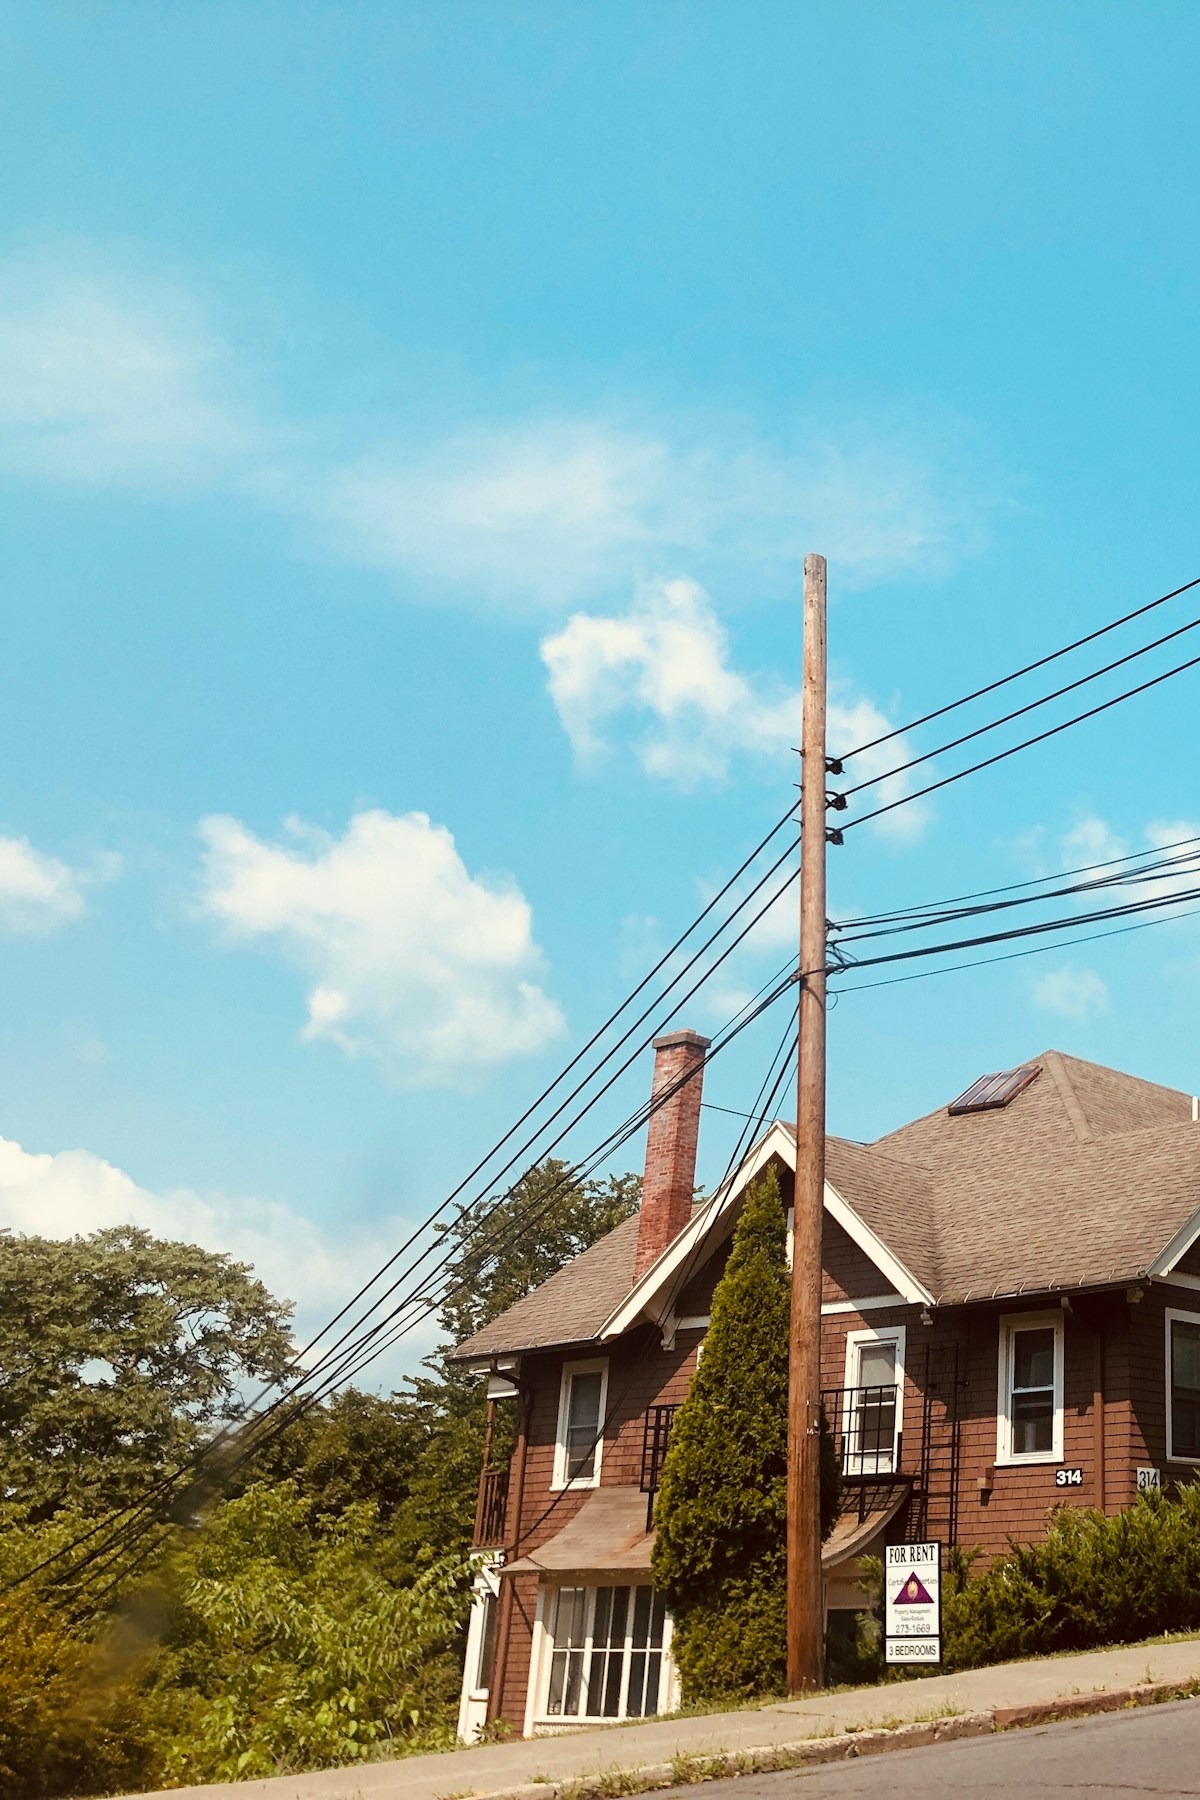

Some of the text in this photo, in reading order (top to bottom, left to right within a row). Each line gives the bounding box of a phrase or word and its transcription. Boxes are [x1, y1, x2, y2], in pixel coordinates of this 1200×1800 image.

[1056, 1470, 1082, 1485] 314
[1139, 1471, 1158, 1489] 314
[889, 1545, 935, 1563] FOR RENT
[895, 1624, 931, 1633] 273-1669
[889, 1645, 936, 1656] 3 BEDROOMS
